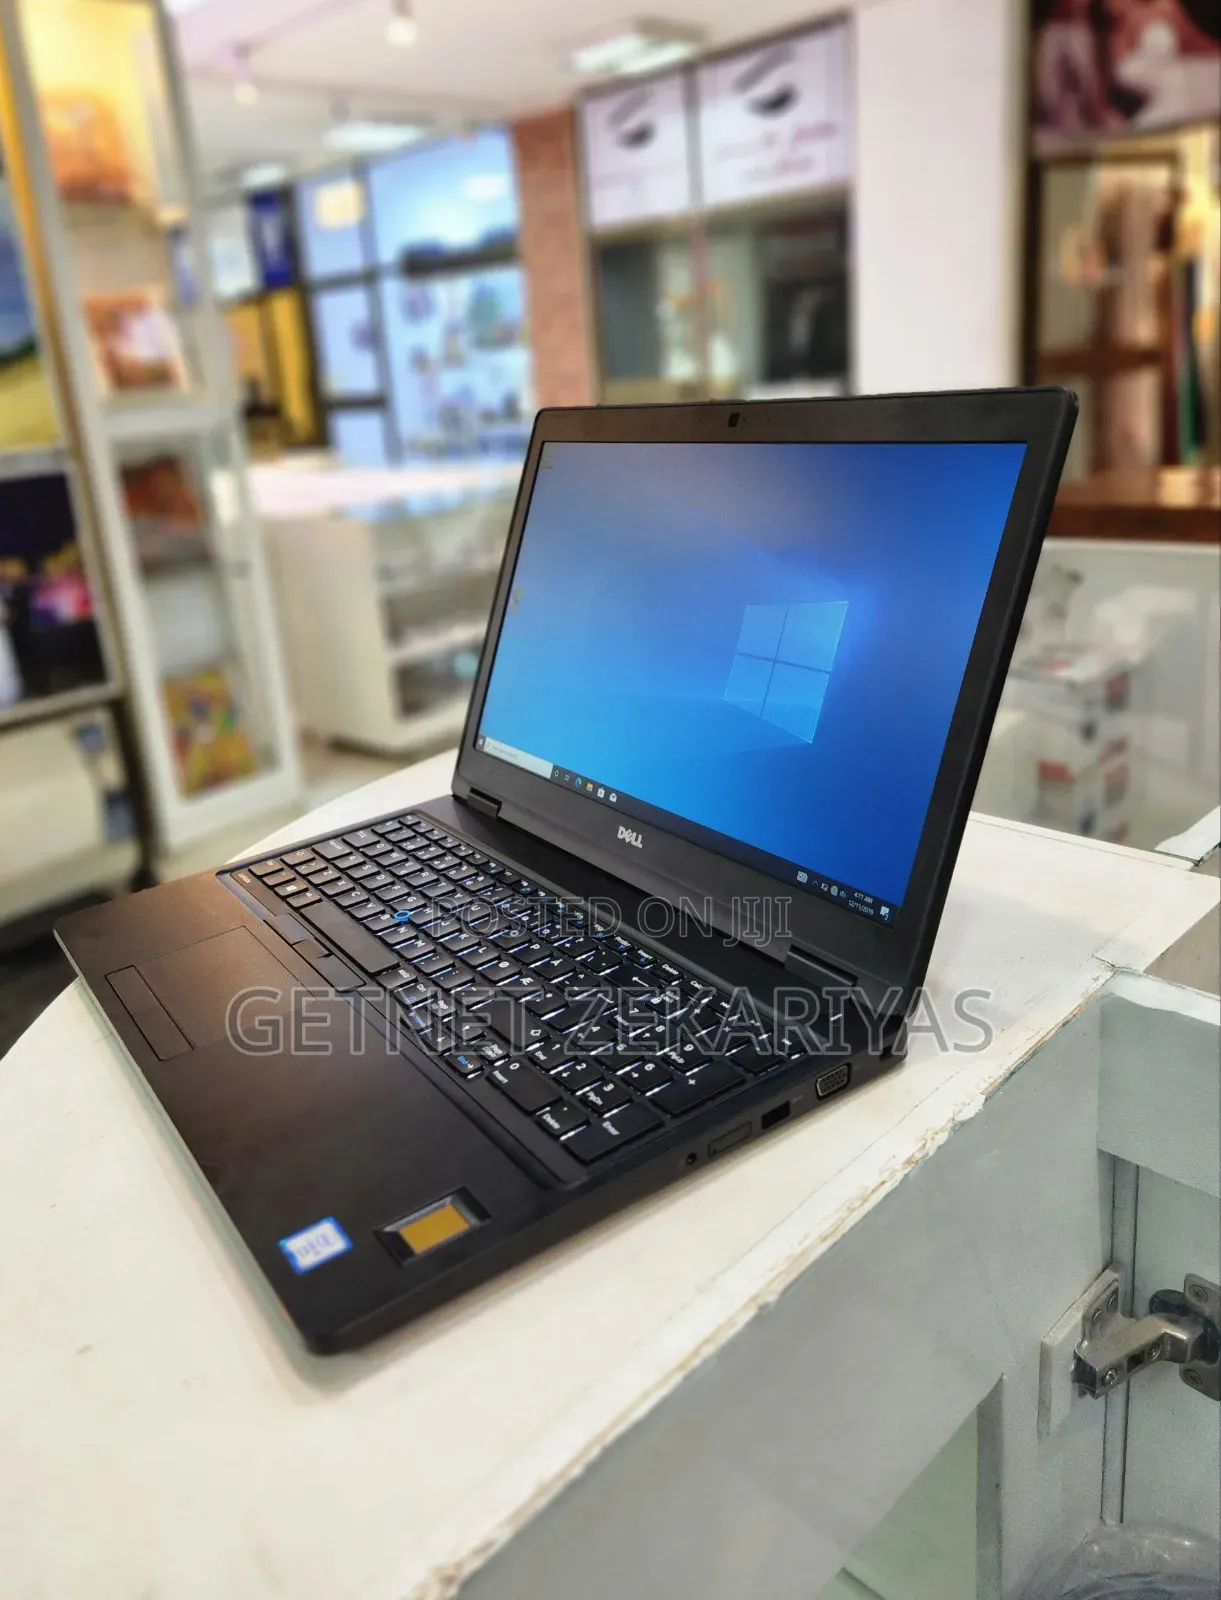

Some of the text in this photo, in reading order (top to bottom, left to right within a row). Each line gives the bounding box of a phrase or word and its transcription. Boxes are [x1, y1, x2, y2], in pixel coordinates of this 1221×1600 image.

[617, 825, 643, 848] DELL
[864, 895, 873, 904] AM
[662, 964, 679, 975] Delete
[520, 977, 533, 985] Æ
[534, 1051, 547, 1060] End
[645, 1063, 655, 1071] 6
[493, 1070, 508, 1083] Insert
[603, 1083, 614, 1091] 3
[586, 1091, 603, 1105] PgDn
[542, 1113, 560, 1129] Delete
[602, 1121, 619, 1135] Enter
